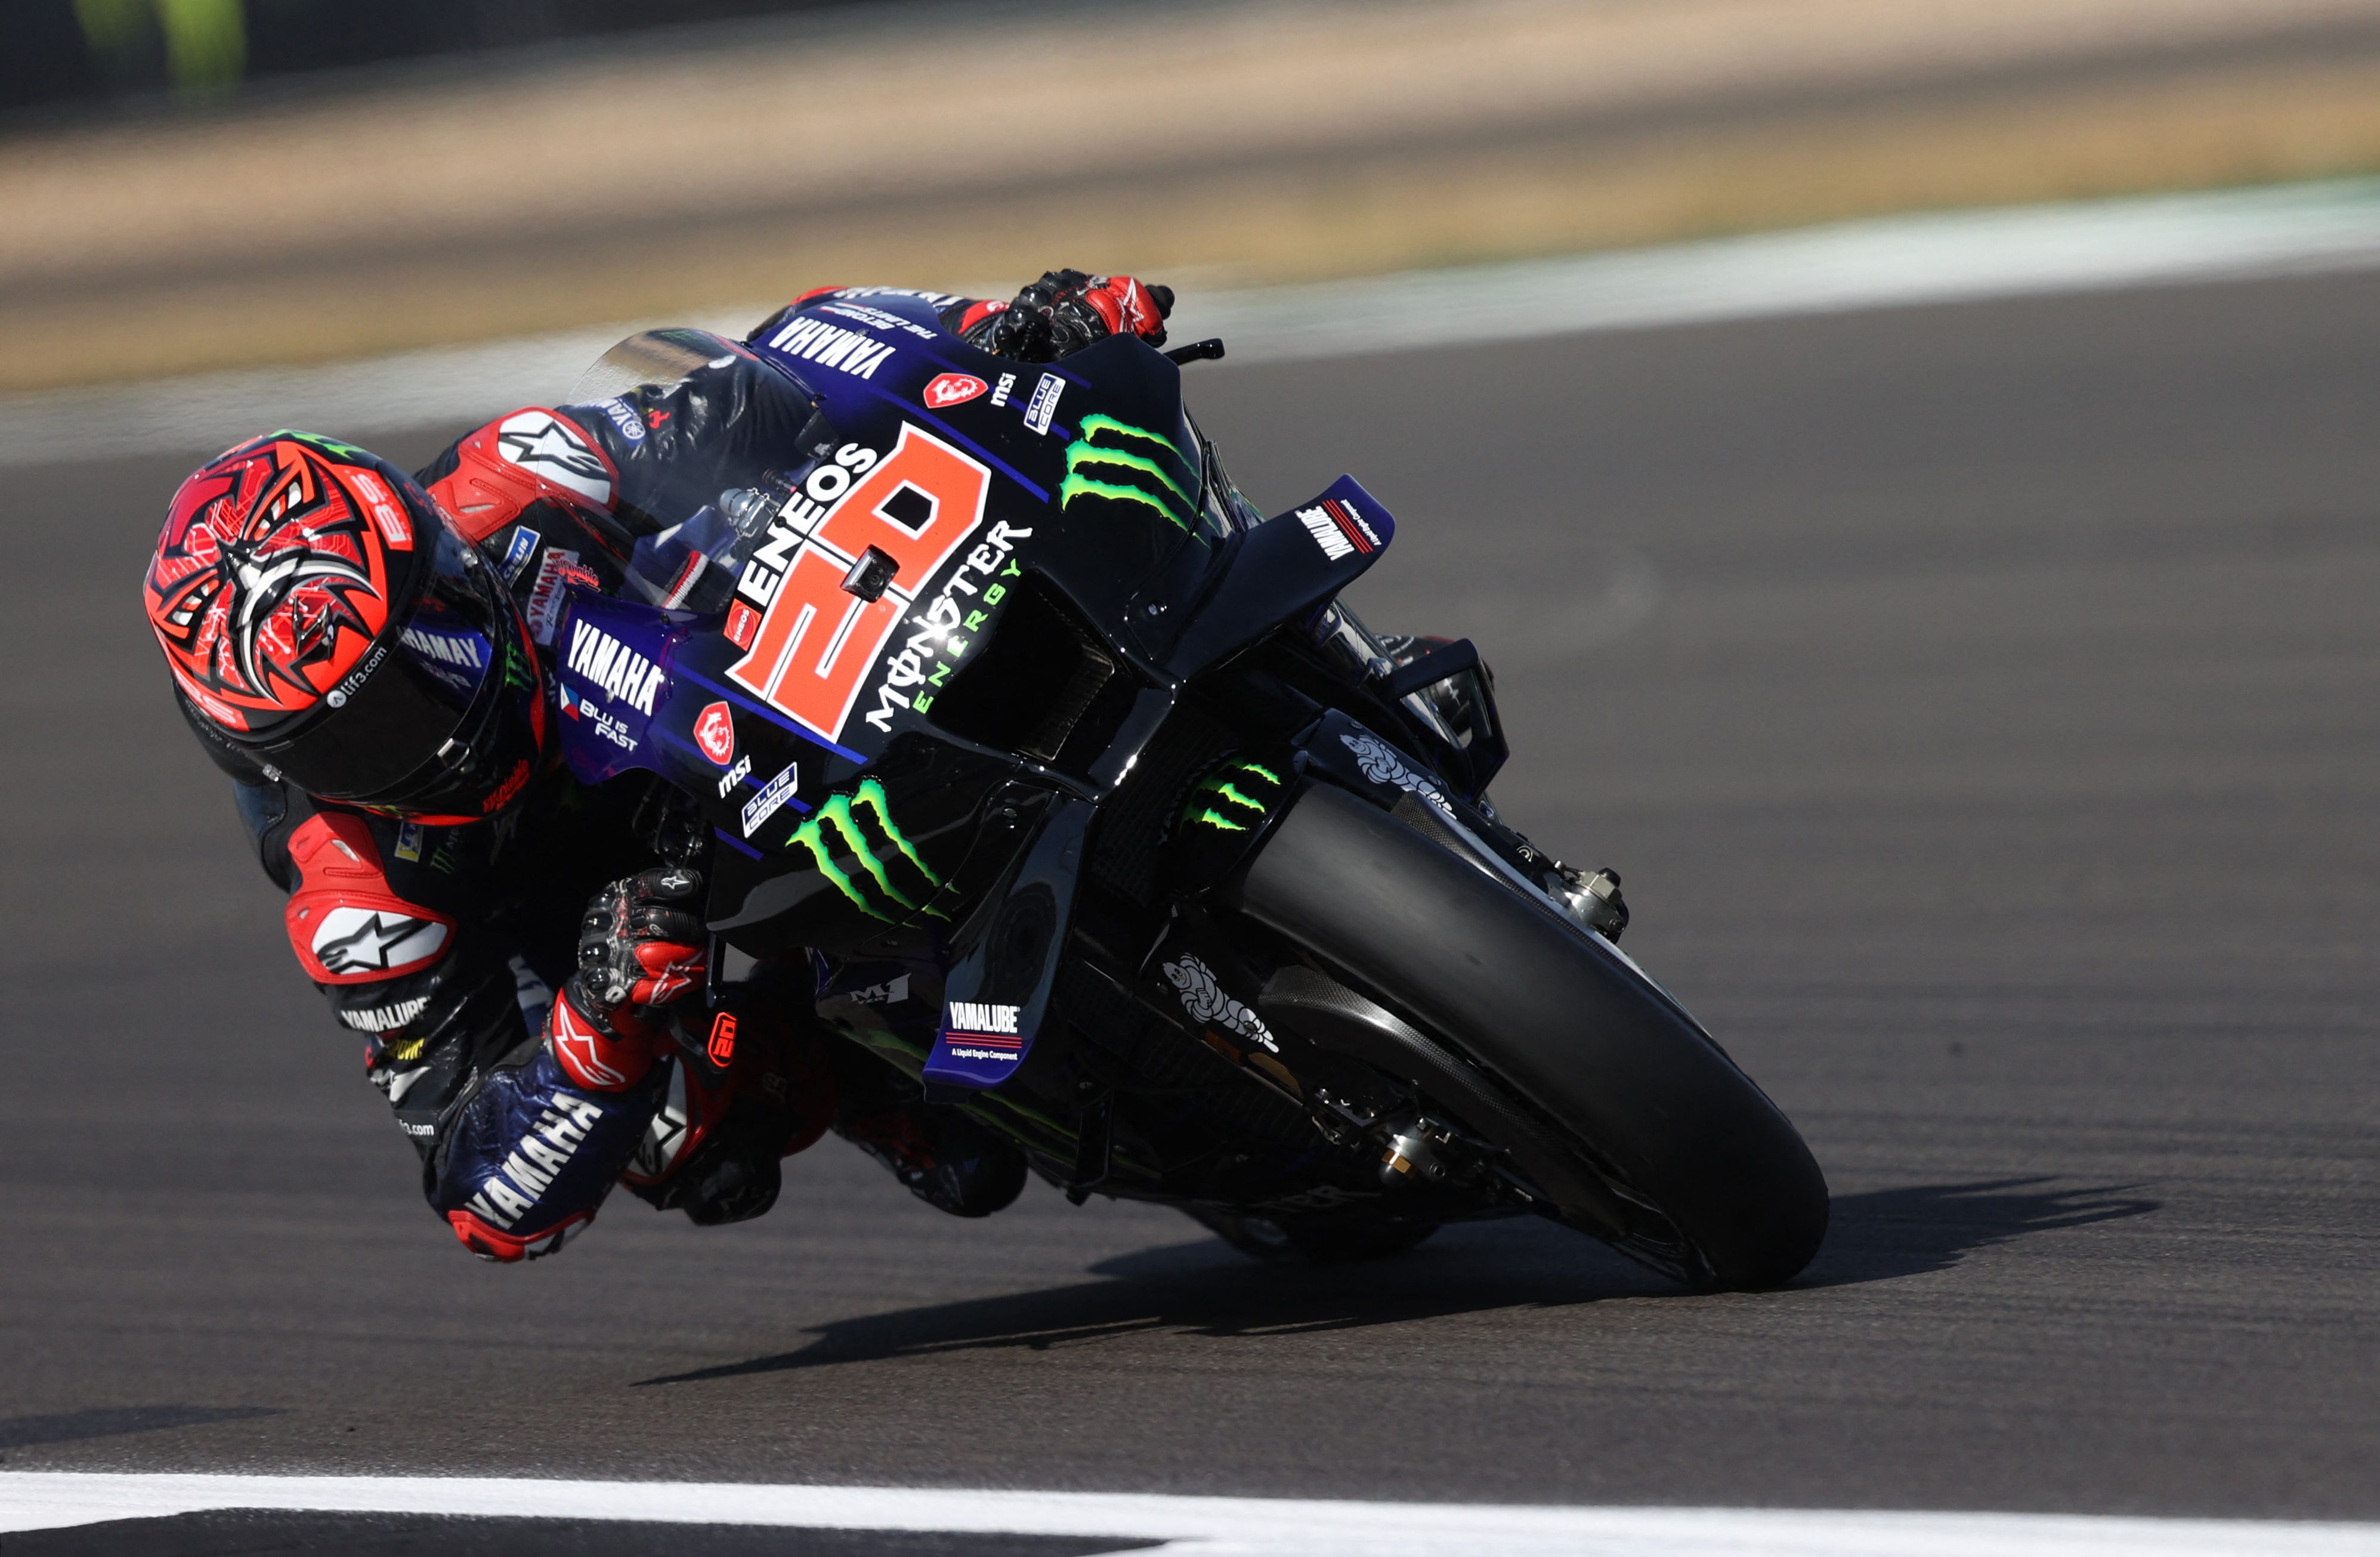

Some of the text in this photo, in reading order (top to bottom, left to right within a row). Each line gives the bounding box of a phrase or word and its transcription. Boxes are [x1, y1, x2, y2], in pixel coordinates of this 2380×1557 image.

[865, 307, 938, 340] THE LIMITS
[768, 316, 897, 380] YAMAHA
[990, 372, 1017, 407] msi
[1028, 378, 1052, 422] BLUE
[1040, 383, 1062, 427] CORE
[737, 442, 878, 607] ENEOS
[1296, 505, 1355, 561] YAMALUBE
[502, 536, 530, 581] CHELIN
[530, 551, 565, 617] YAMAHA
[724, 420, 992, 745] 20
[733, 608, 750, 642] ENEOS
[865, 519, 1033, 733] MONSTER
[912, 558, 1023, 714] ENERGY
[340, 647, 388, 696] lif3.com
[567, 618, 664, 717] YAMAHA
[579, 698, 629, 735] BLU IS
[595, 722, 638, 752] FAST
[718, 754, 752, 799] msi
[746, 770, 790, 818] BLUE
[749, 786, 790, 830] CORE
[848, 973, 912, 1004] M1
[713, 1019, 737, 1058] 20
[949, 1001, 1018, 1033] YAMALUBE
[951, 1048, 1018, 1061] A Liquid Engine Component
[465, 1091, 604, 1231] YAMAHA
